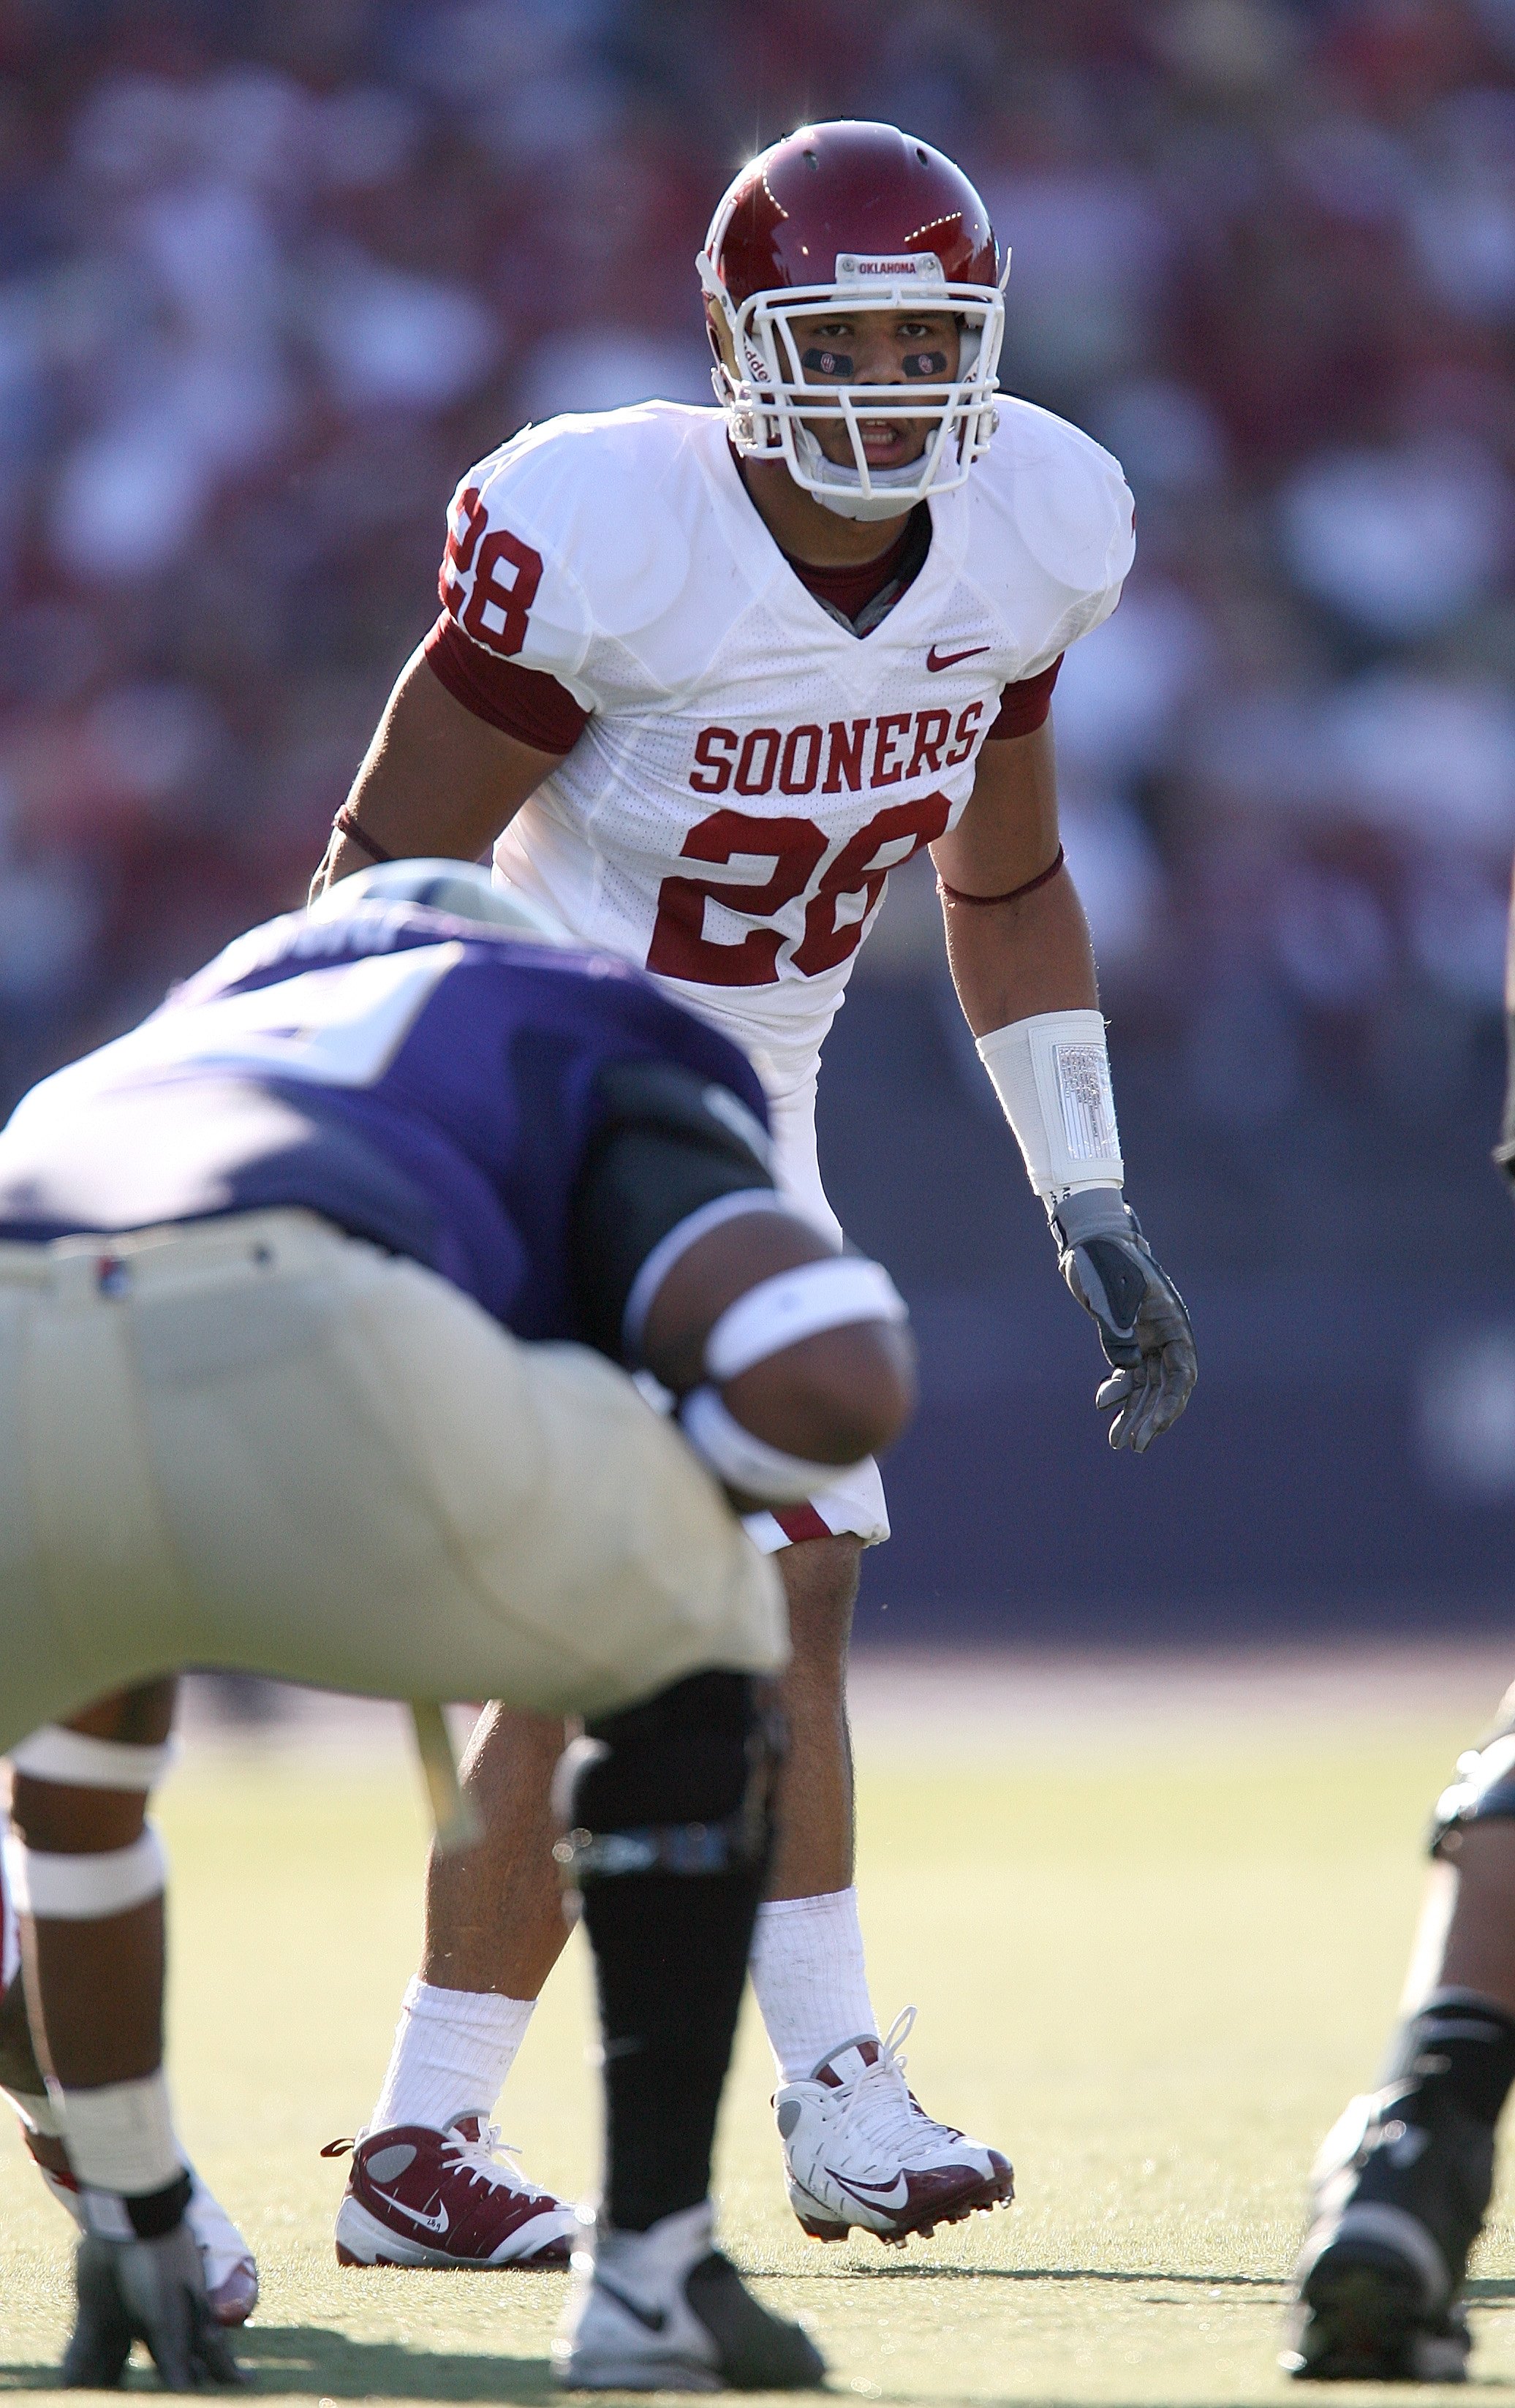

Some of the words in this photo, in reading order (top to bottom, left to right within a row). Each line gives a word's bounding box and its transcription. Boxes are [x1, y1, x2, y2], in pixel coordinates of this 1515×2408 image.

[859, 262, 916, 274] OKLAHOMA
[439, 488, 543, 656] 28
[689, 701, 983, 795] SOONERS
[646, 791, 953, 986] 28
